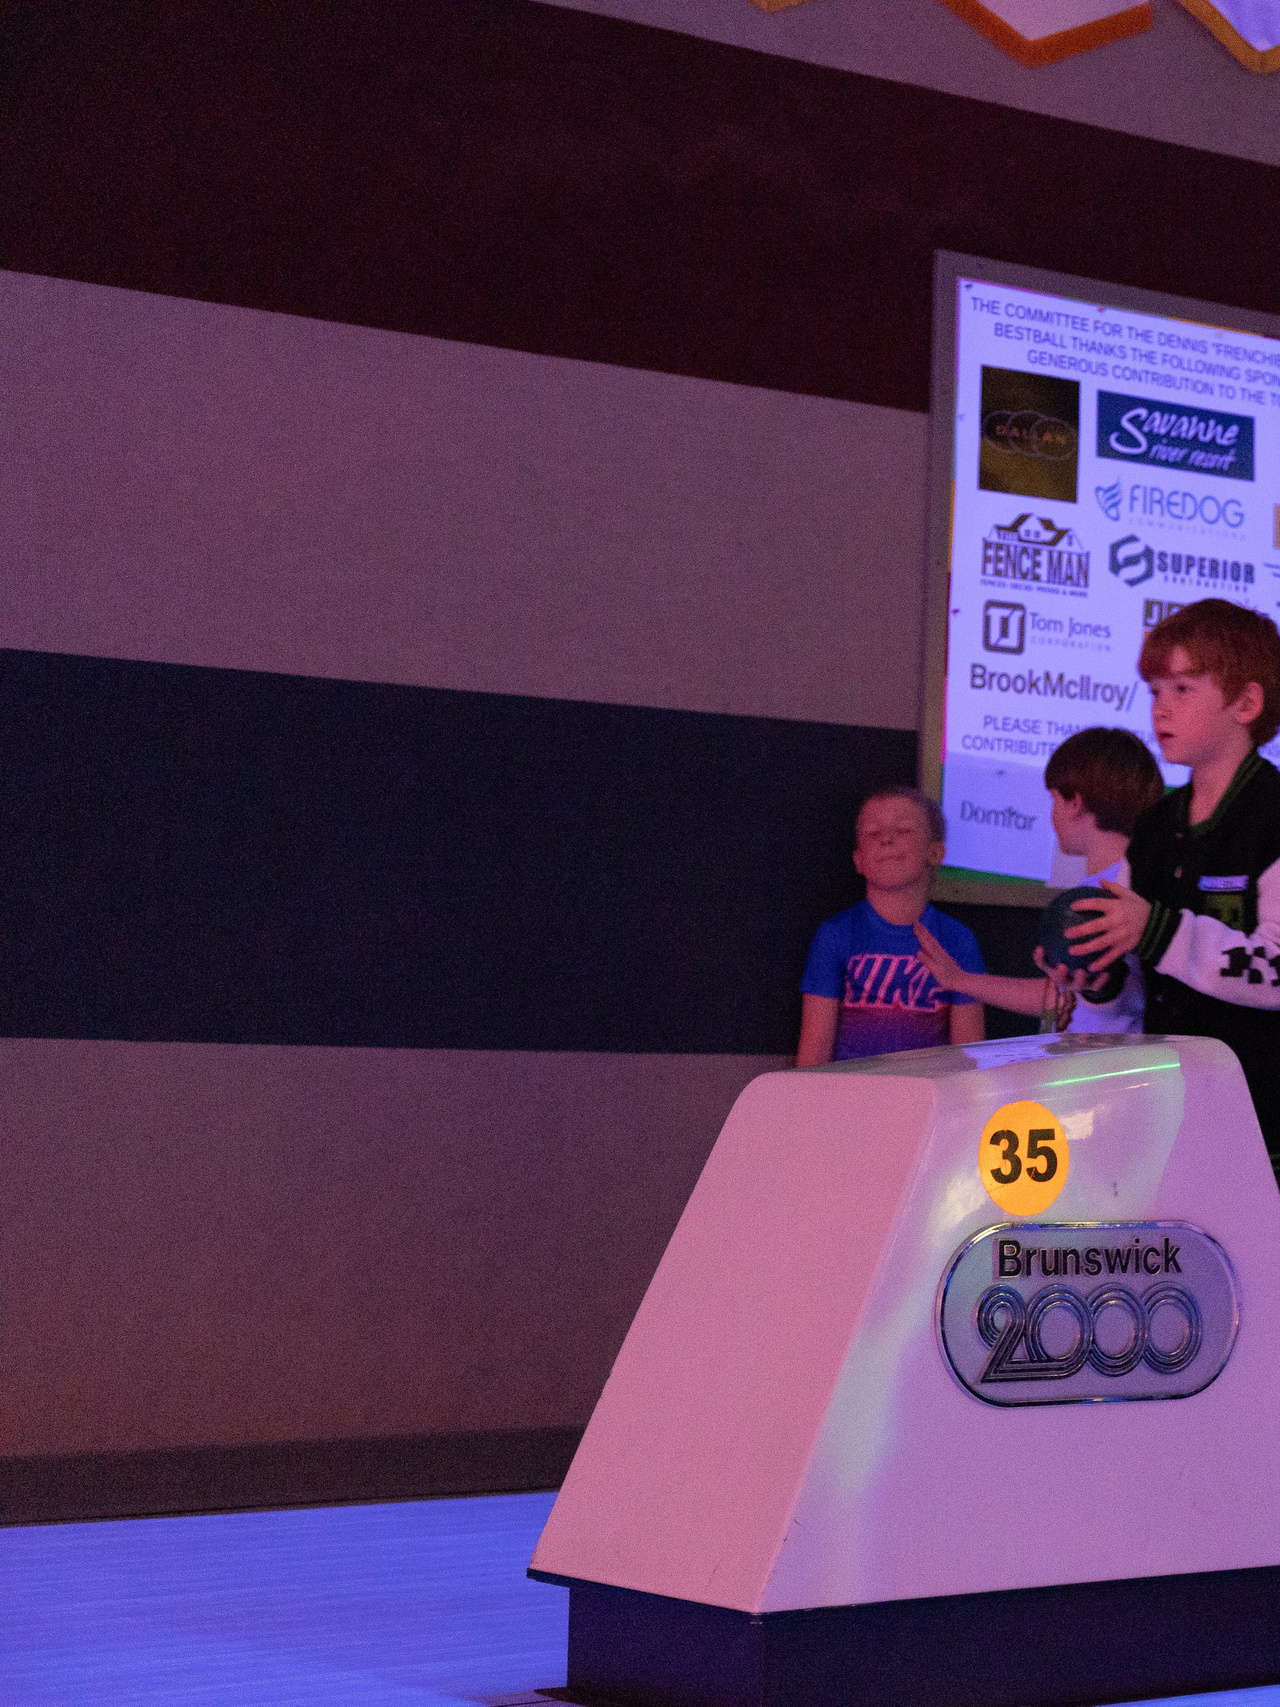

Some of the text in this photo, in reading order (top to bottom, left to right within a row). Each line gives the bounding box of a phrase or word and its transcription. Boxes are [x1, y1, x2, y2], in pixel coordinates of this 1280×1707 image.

[971, 296, 999, 315] THE
[1004, 301, 1090, 333] COMMITTEE
[1093, 319, 1123, 339] FOR
[1126, 325, 1154, 345] THE
[1157, 331, 1208, 355] DENNIS
[994, 321, 1067, 350] BESTBALL
[1071, 335, 1128, 361] THANKS
[1131, 346, 1159, 366] THE
[1161, 352, 1242, 382] FOLLOWING
[1027, 348, 1109, 378] GENEROUS
[1111, 364, 1215, 397] CONTRIBUTION
[1218, 383, 1236, 400] TO
[1239, 387, 1266, 406] THE
[1129, 484, 1245, 528] FIREDOG
[981, 537, 1091, 588] FENCE MAN
[1157, 551, 1254, 584] SUPERIOR
[1030, 611, 1063, 633] Tom
[1068, 616, 1111, 639] Jones
[983, 714, 1042, 735] PLEASE
[960, 800, 1036, 831] Domtar
[989, 1127, 1058, 1184] 35
[997, 1237, 1183, 1279] Brunswick
[976, 1281, 1203, 1384] 2000
